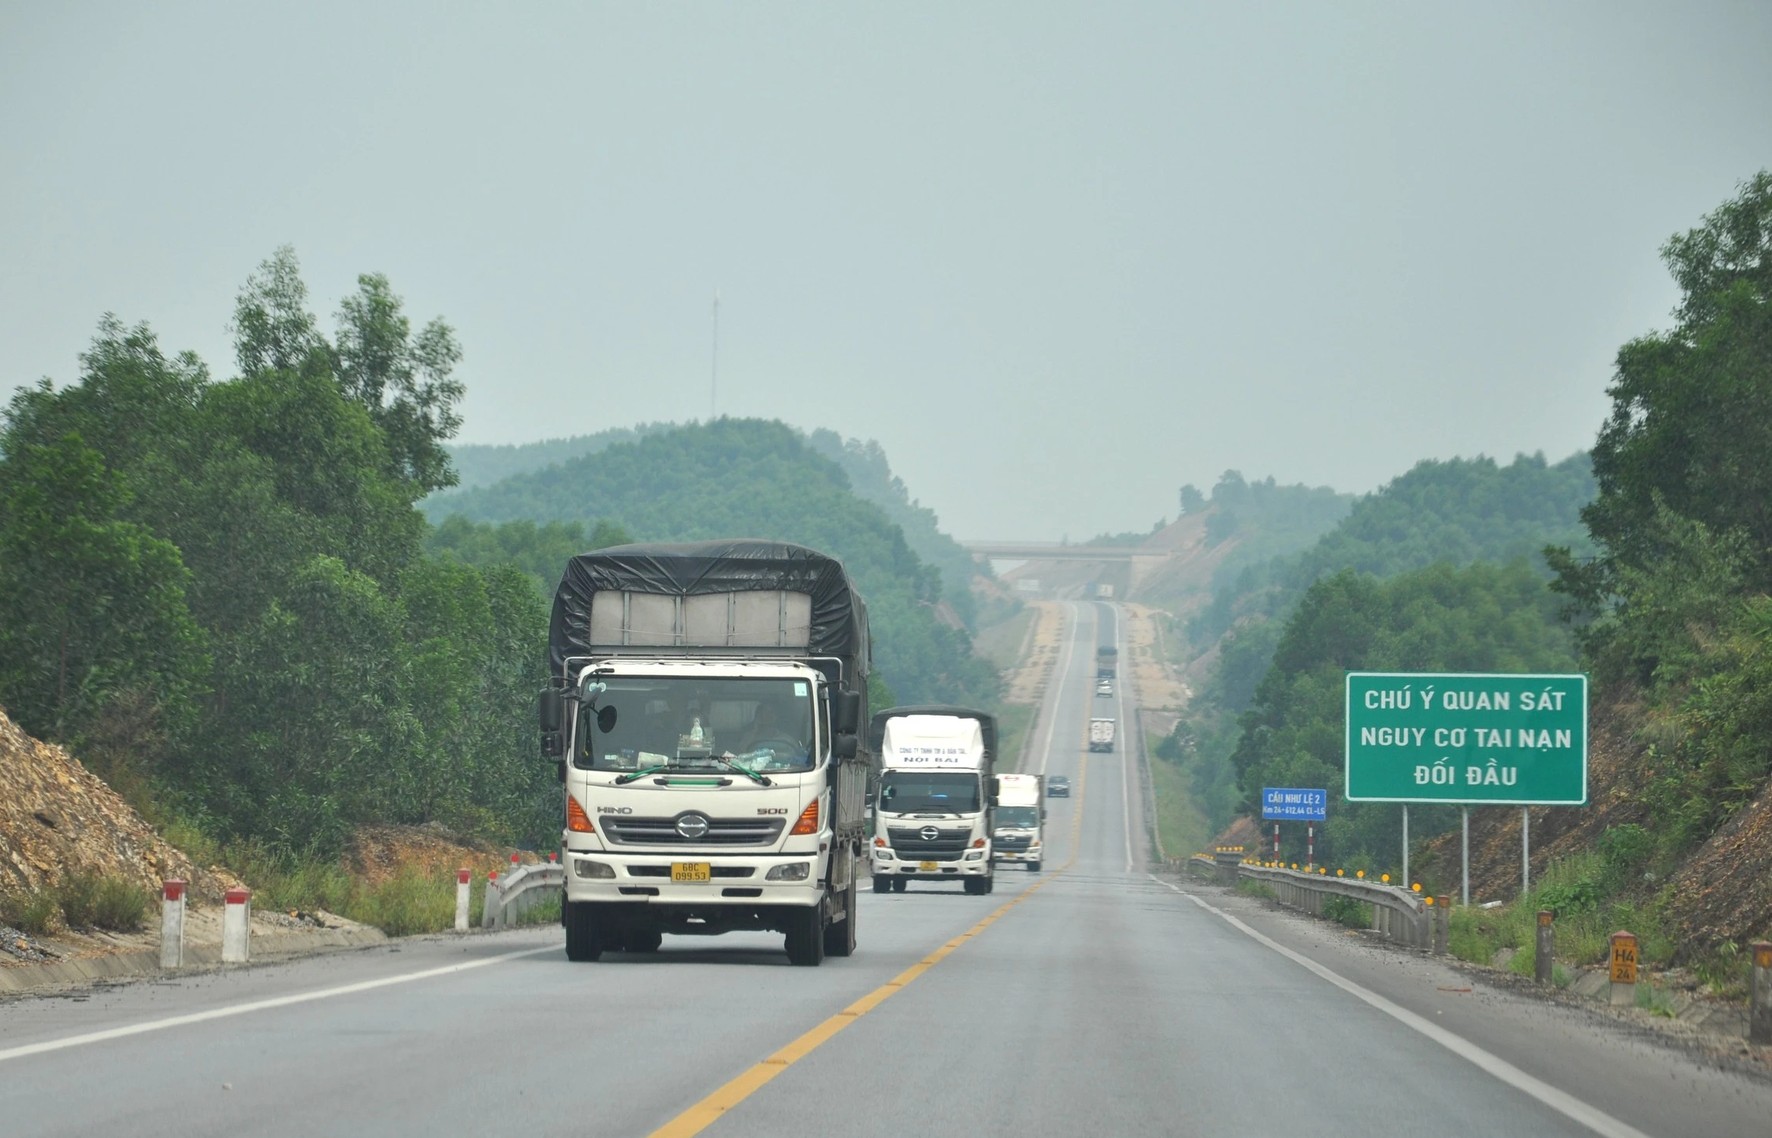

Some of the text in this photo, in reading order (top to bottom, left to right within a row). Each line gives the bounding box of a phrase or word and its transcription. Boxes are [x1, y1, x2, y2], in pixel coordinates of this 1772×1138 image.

[1364, 685, 1566, 711] CHÚ Ý QUAN SÁT
[1361, 727, 1571, 752] NGUY CƠ TAI NẠN
[1414, 757, 1517, 786] ĐỐI ĐẦU
[1285, 793, 1302, 804] NHƯ
[1314, 794, 1321, 804] 2
[597, 806, 633, 815] HINO
[675, 872, 706, 881] 099.53
[1615, 949, 1635, 962] H4
[1616, 968, 1630, 979] 24
